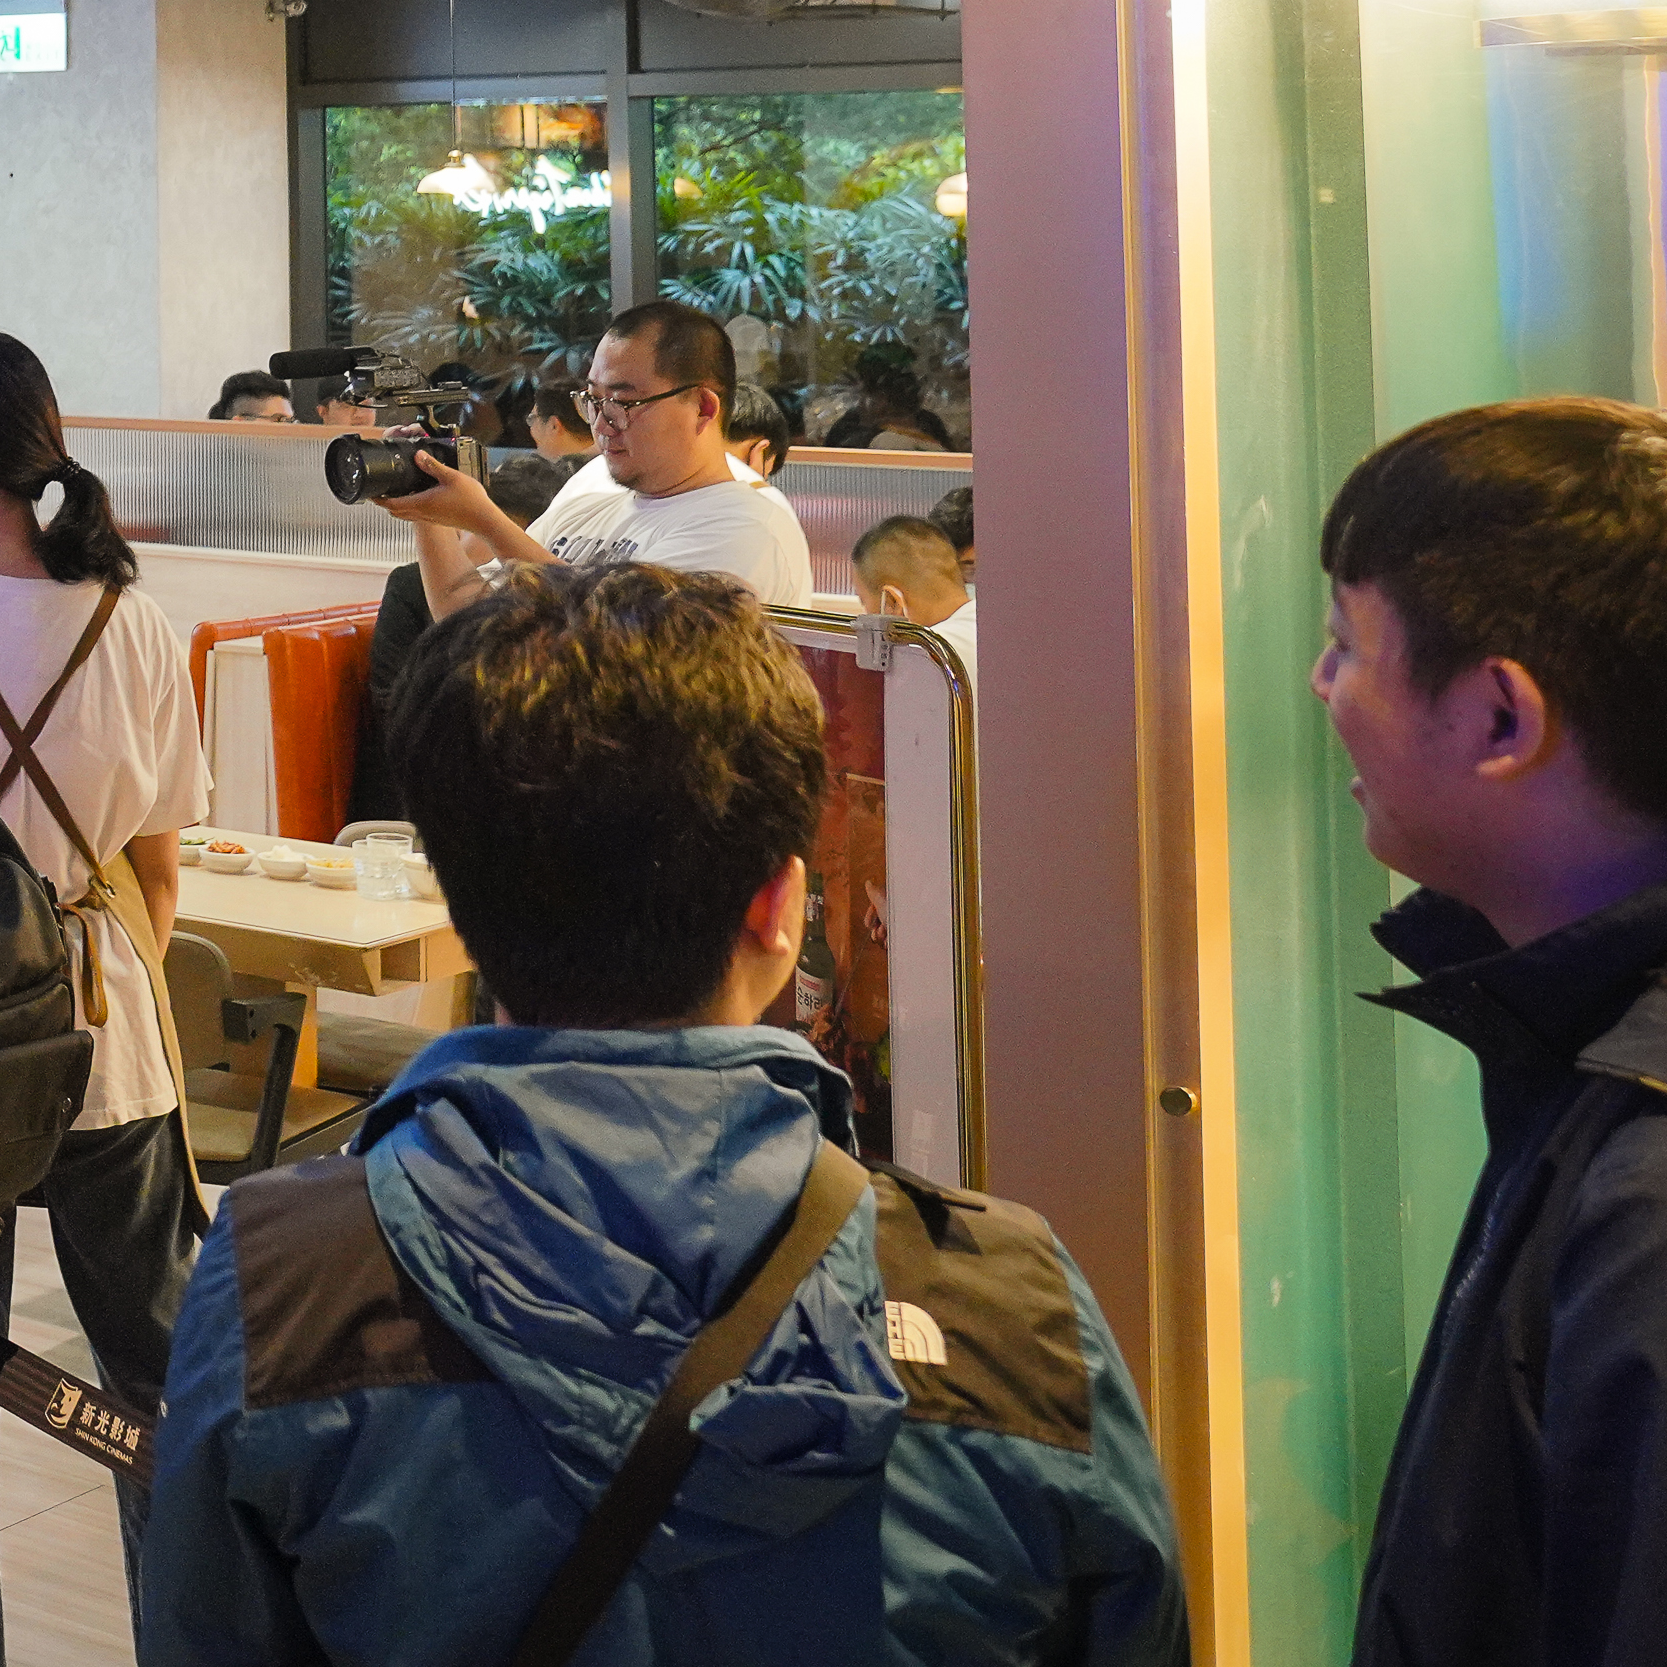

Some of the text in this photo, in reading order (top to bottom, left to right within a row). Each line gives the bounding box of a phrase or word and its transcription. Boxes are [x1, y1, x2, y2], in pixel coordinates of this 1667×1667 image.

[75, 1427, 133, 1465] SHIN KONG CINEMAS
[80, 1401, 141, 1451] 新光影城
